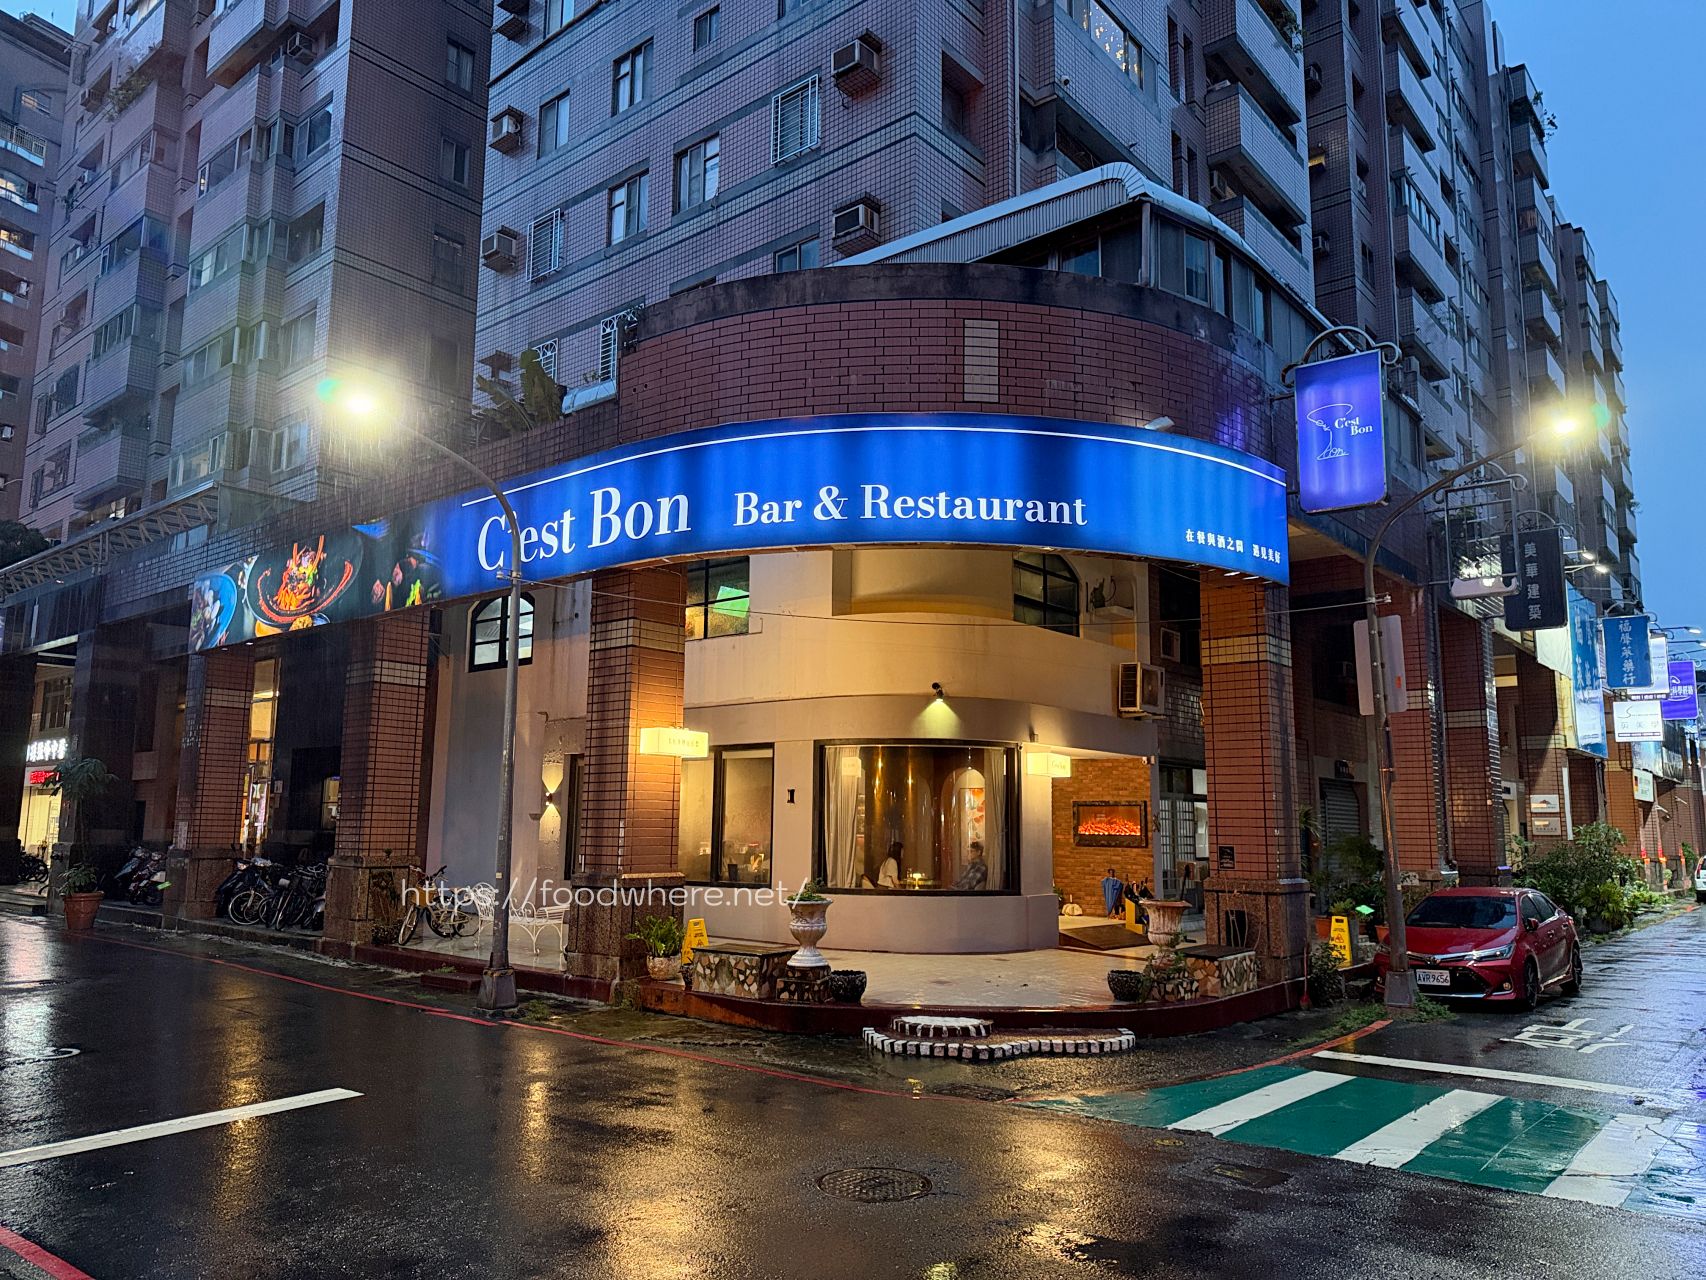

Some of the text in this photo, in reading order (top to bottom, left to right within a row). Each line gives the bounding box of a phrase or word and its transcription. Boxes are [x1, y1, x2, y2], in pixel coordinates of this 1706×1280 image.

[1334, 416, 1360, 429] C'est
[1350, 425, 1373, 436] Bon
[587, 486, 692, 549] Bon
[733, 492, 803, 527] Bar
[813, 485, 848, 520] &
[860, 484, 1088, 526] Restaurant
[1185, 528, 1281, 564] 在餐與酒之間 遇見美好
[1524, 542, 1541, 620] 美華建築
[1499, 1018, 1636, 1054] 停
